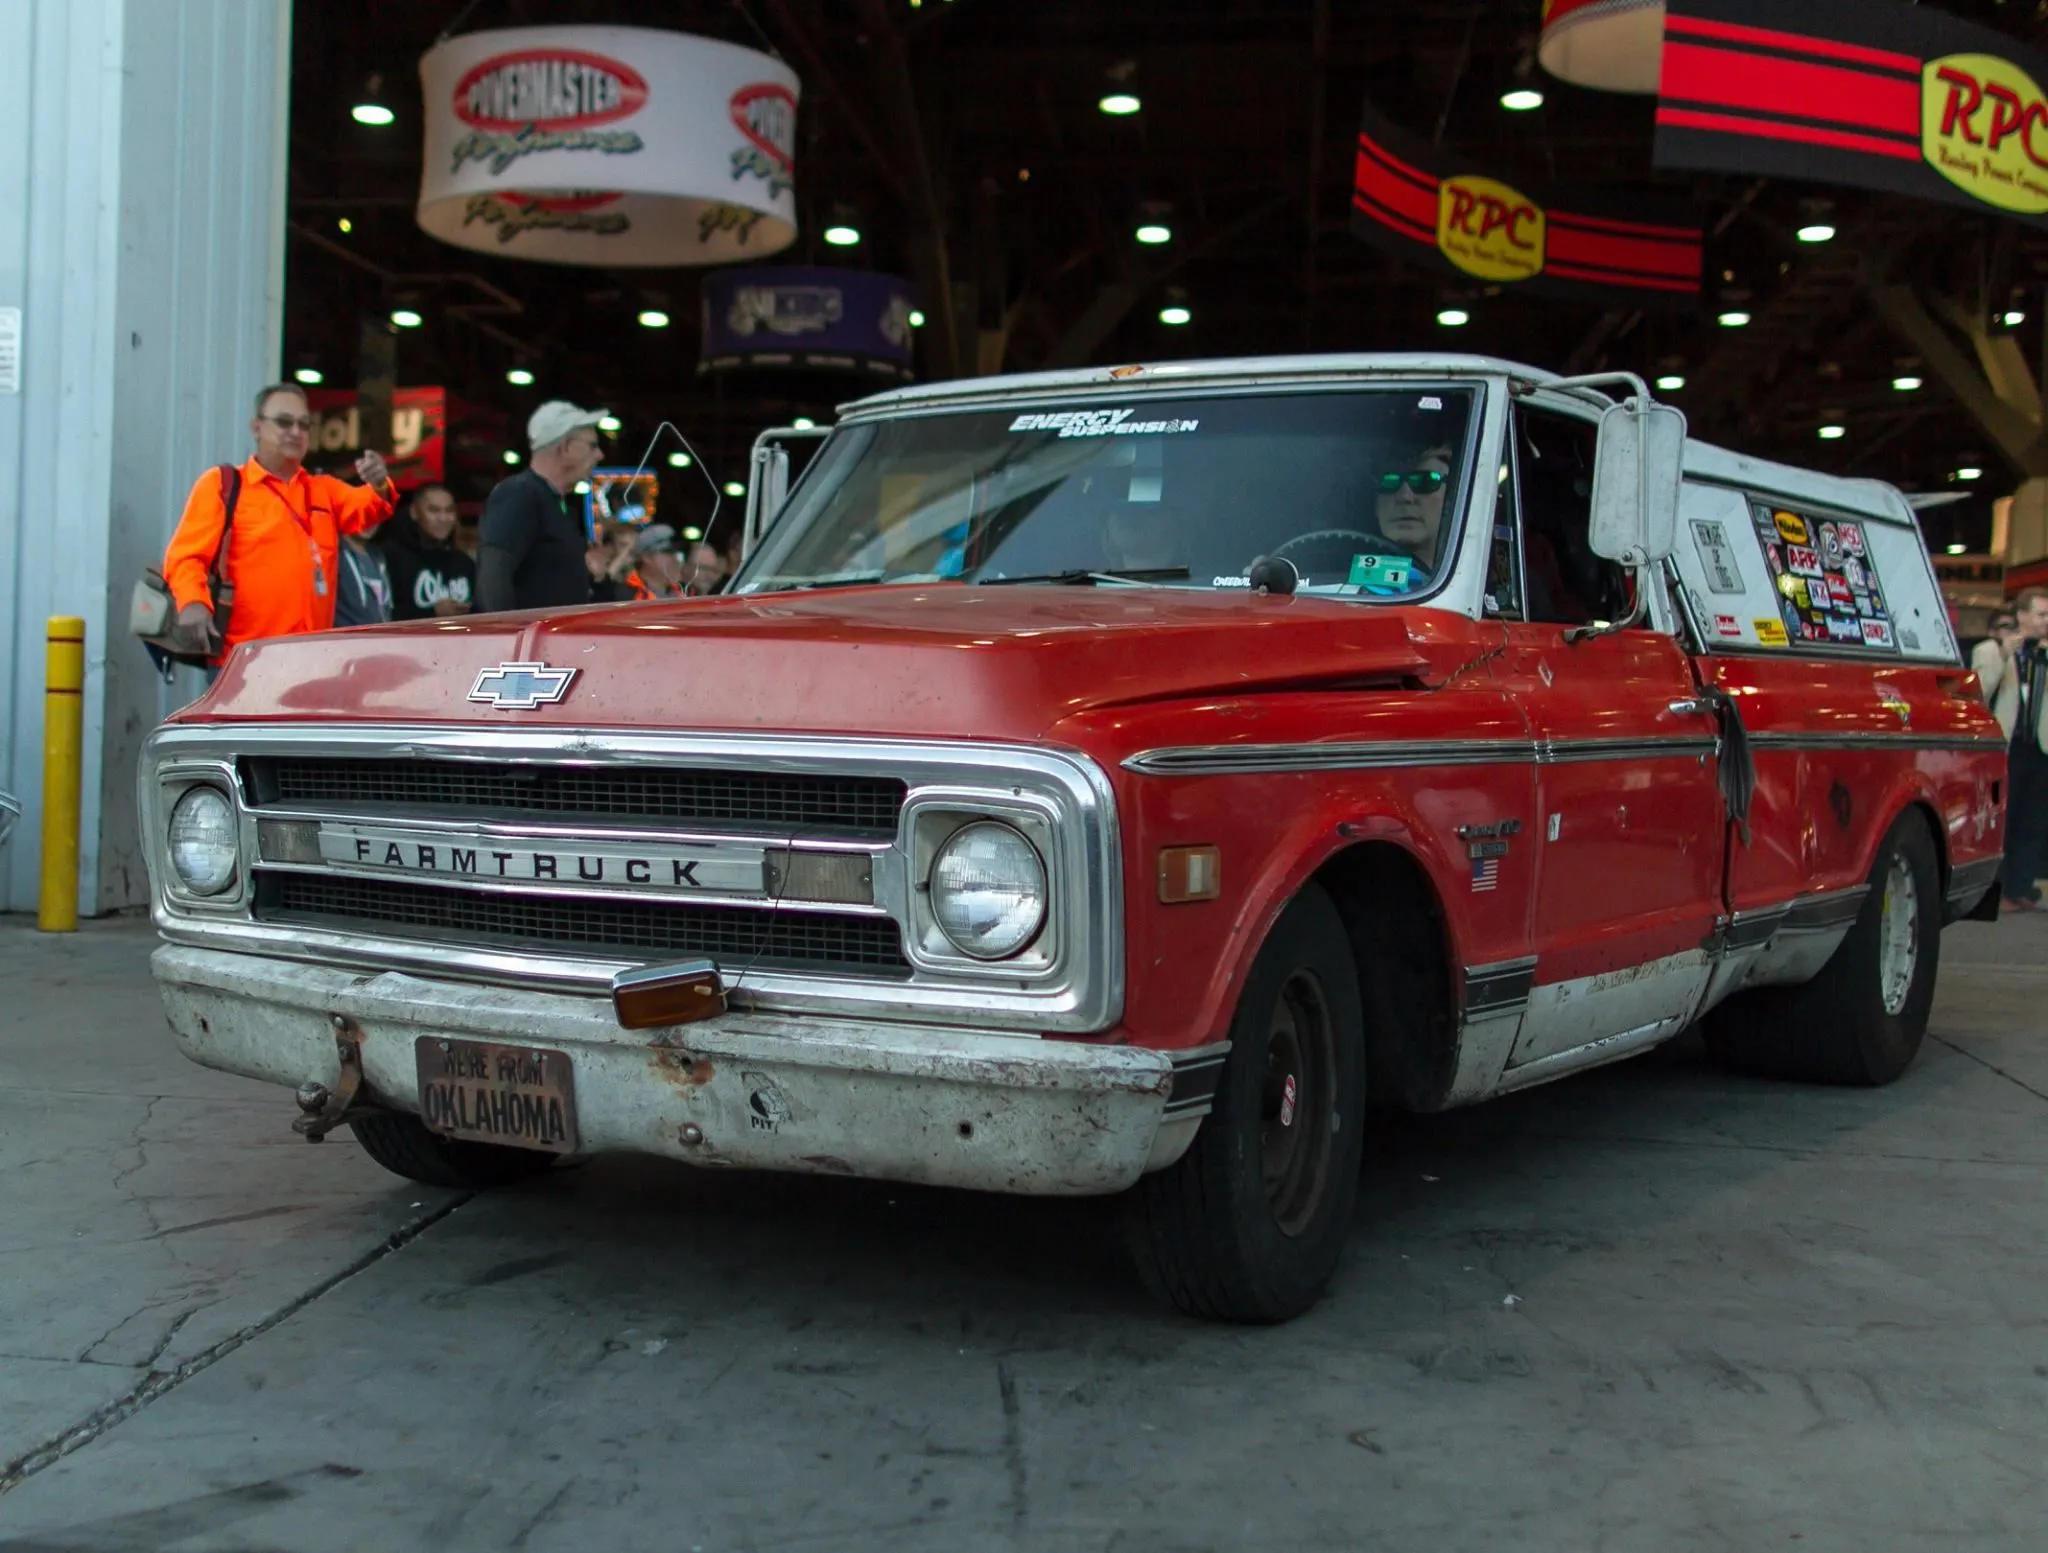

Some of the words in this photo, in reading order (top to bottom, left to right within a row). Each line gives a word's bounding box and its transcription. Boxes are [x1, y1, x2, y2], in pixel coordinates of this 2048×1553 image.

[1936, 64, 2048, 170] RPC
[1447, 184, 1536, 252] RPC
[1008, 409, 1135, 431] ENERGY
[1364, 556, 1377, 568] 9
[1390, 571, 1400, 582] 1
[1789, 547, 1818, 571] ARP
[355, 839, 702, 887] FARMTRUCK
[424, 1083, 567, 1142] OKLAHOMA
